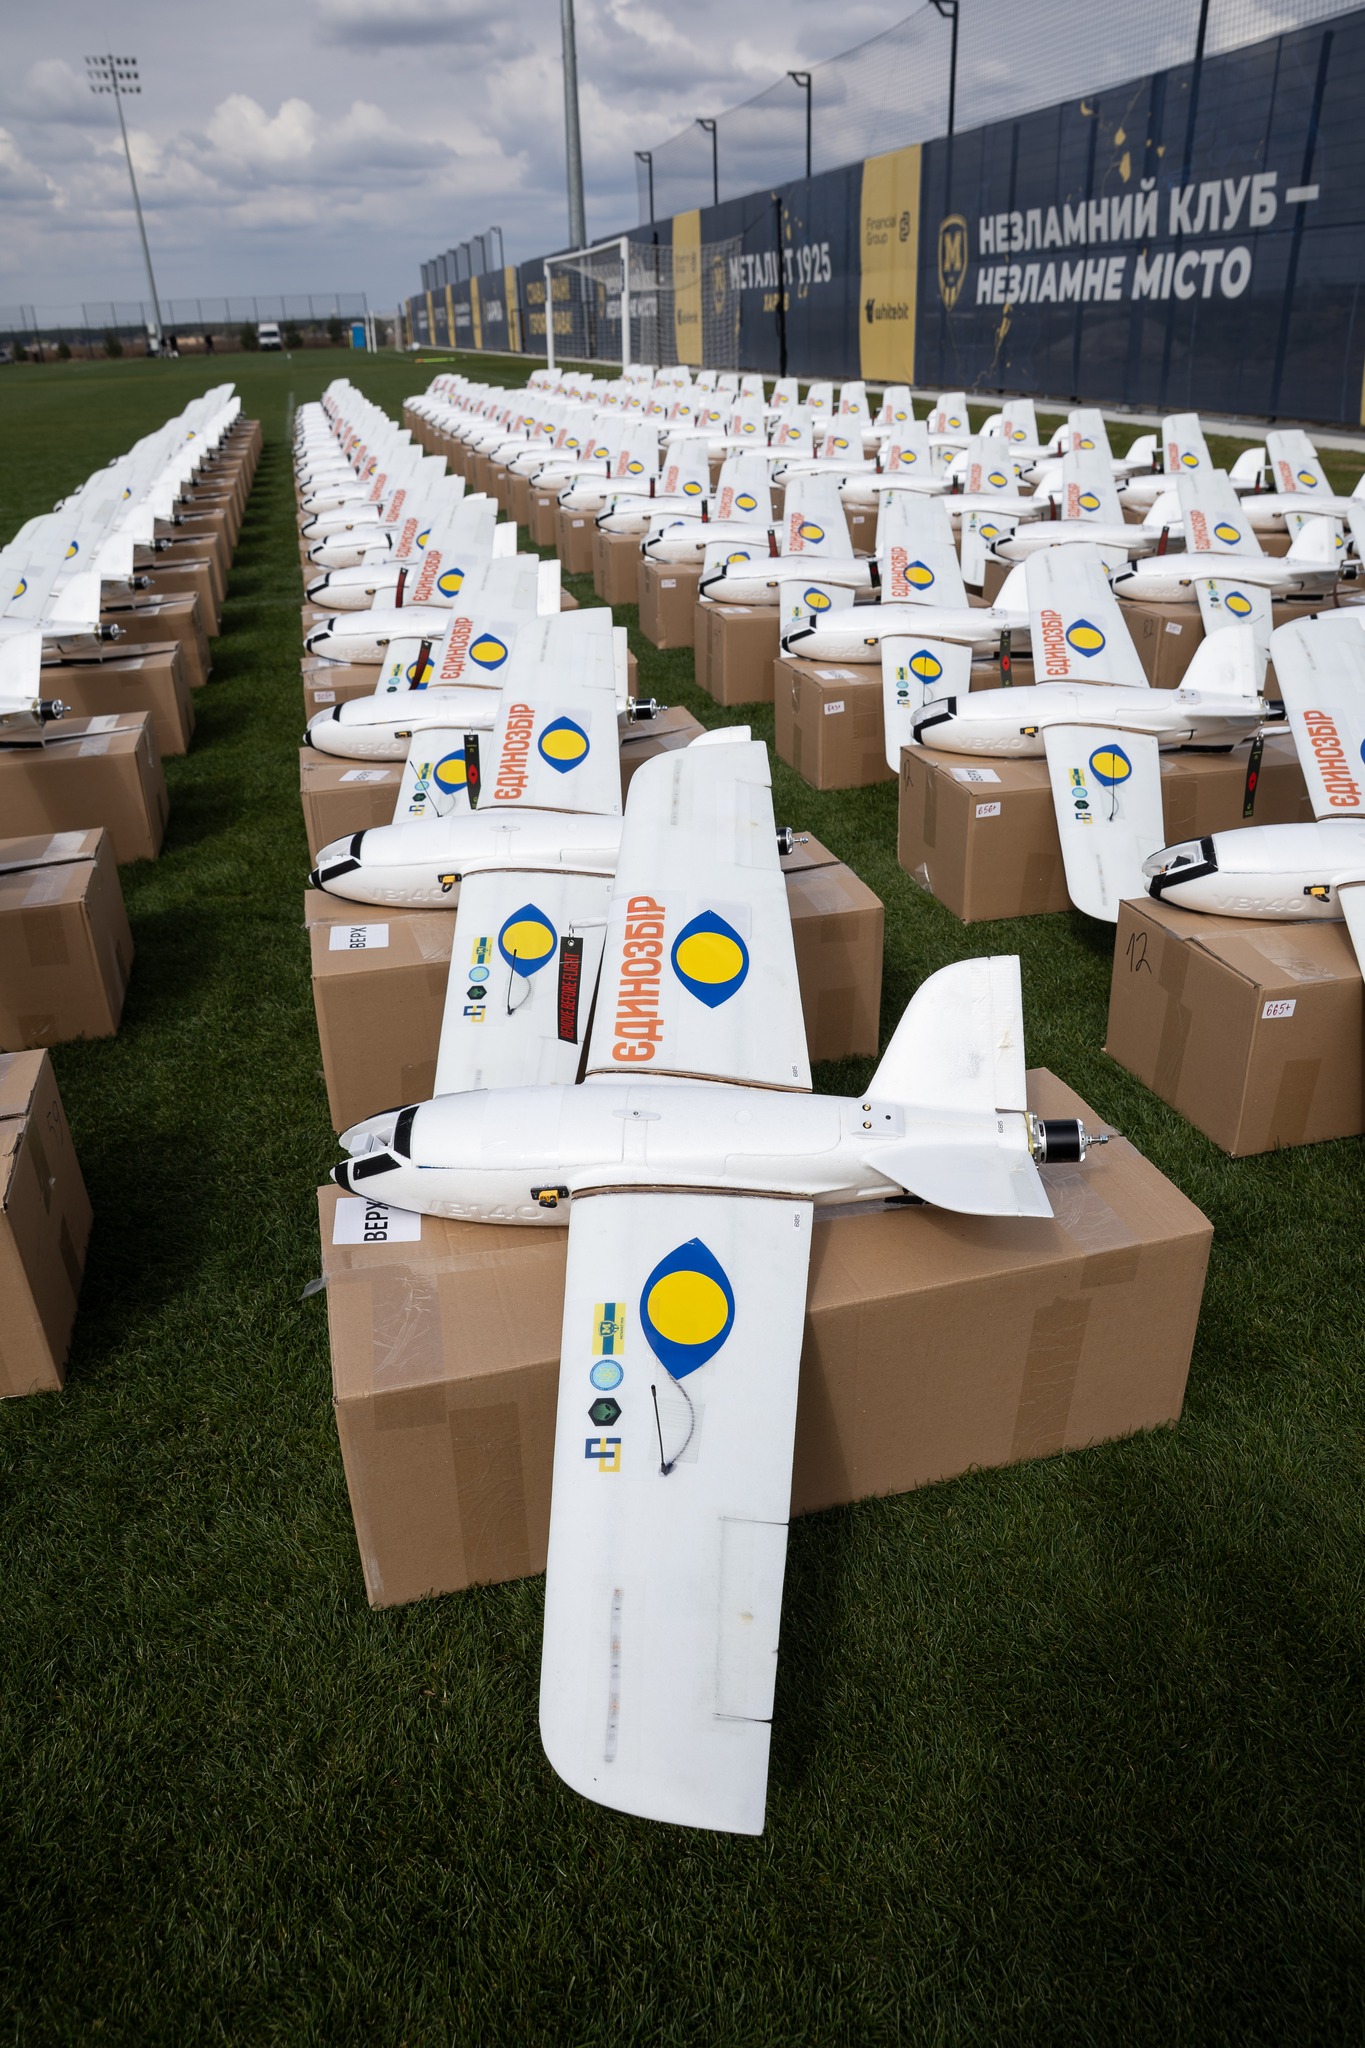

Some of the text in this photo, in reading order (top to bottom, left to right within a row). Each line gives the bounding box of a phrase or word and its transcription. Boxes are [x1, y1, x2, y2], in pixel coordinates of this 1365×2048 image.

[979, 176, 1159, 255] НЕЗЛАМНИЙ
[1169, 171, 1278, 236] КЛУБ
[729, 248, 793, 290] МЕТАЛІТ
[797, 242, 832, 284] 1925
[976, 246, 1252, 305] НЕЗЛАМНЕ МІСТО
[412, 550, 443, 602] ЄДИНОЗБІР
[440, 617, 473, 680] ЄДИНОЗБІР
[1041, 609, 1071, 676] ЄДИНОЗБІР
[494, 703, 536, 800] ЄДИНОЗБІР
[1303, 710, 1362, 807] ЄДИНОЗБІР
[349, 925, 367, 949] ВЕРХ
[1126, 932, 1152, 974] 12
[560, 952, 580, 1039] REMOVE BEFORE FLIGHT
[612, 895, 666, 1062] ЄДИНОЗБІР
[1266, 1002, 1291, 1017] 665+
[363, 1200, 389, 1242] ВЕРХ
